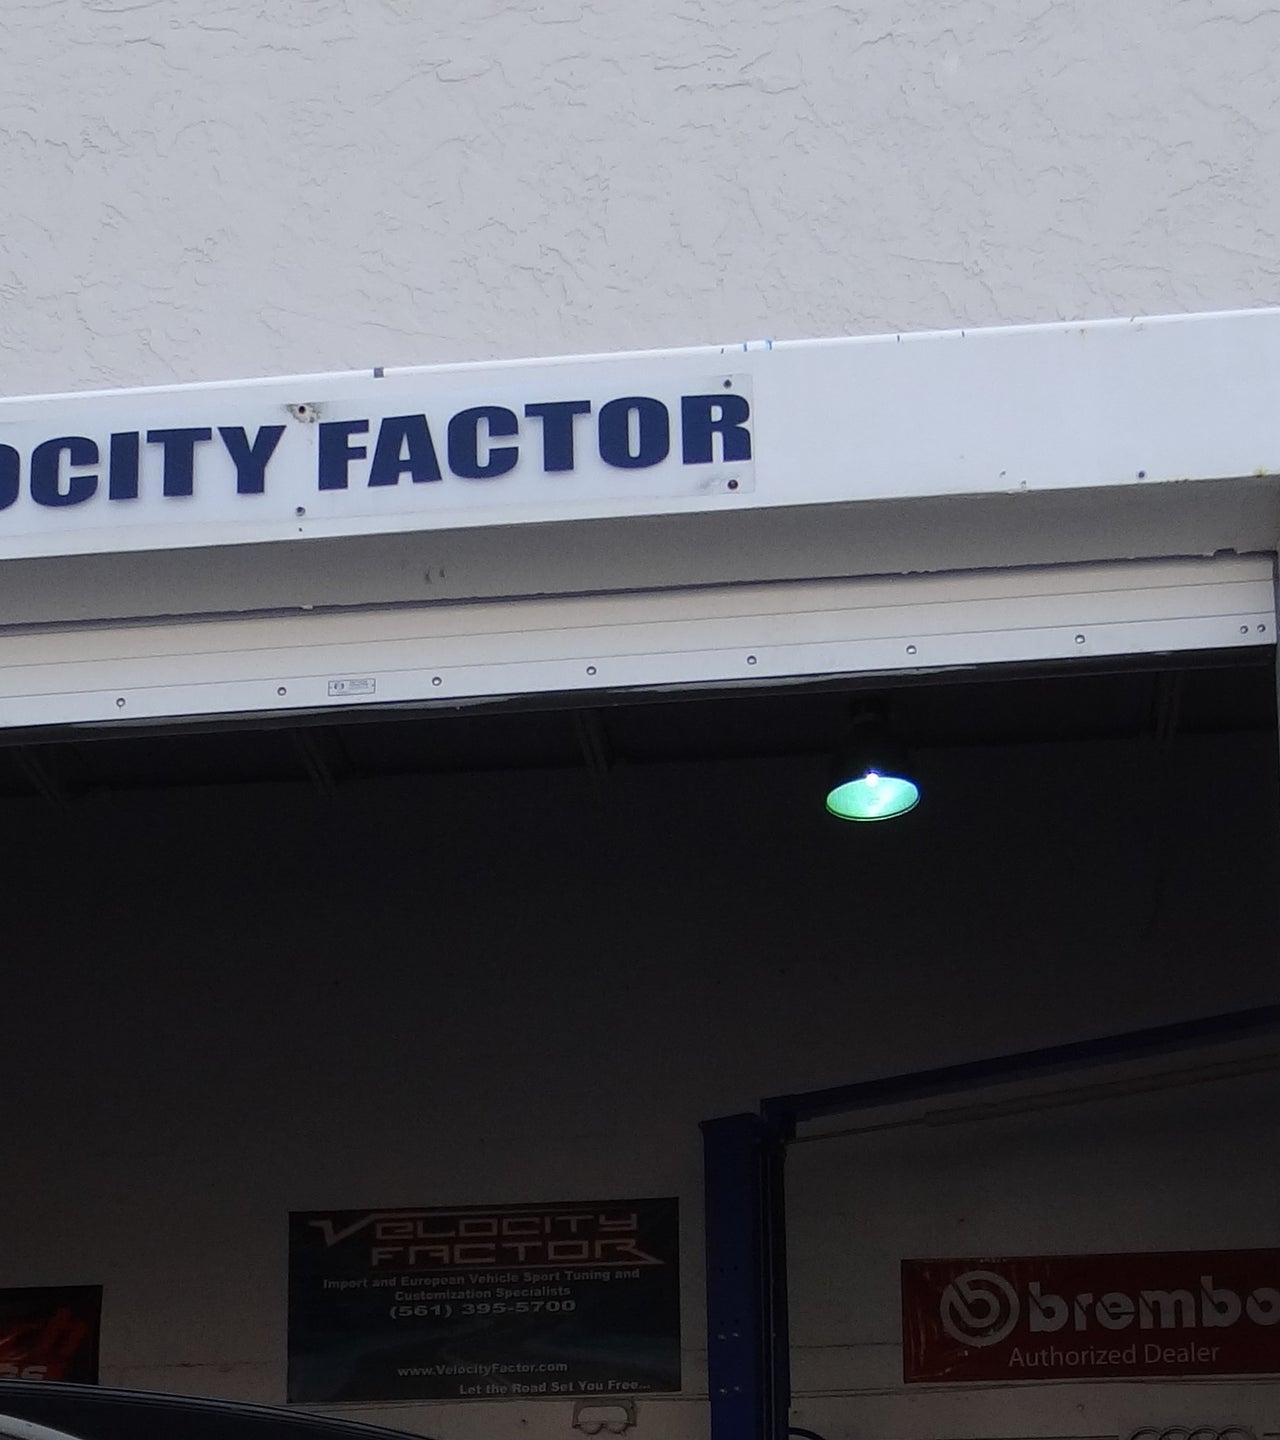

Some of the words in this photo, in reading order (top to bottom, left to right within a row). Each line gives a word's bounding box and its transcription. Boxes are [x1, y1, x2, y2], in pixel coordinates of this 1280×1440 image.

[320, 393, 753, 491] FACTOR
[370, 1237, 665, 1268] FACTOR
[322, 1277, 368, 1291] Import
[371, 1275, 397, 1289] and
[400, 1273, 466, 1289] European
[469, 1271, 521, 1285] Vehicle
[523, 1270, 561, 1285] Sport
[564, 1268, 612, 1283] Tuning
[615, 1267, 641, 1281] and
[394, 1287, 492, 1302] Customization
[494, 1284, 572, 1300] Specialists
[388, 1303, 453, 1319] (561)
[461, 1299, 577, 1317] 395-5700
[1007, 1343, 1138, 1369] Authorized
[1144, 1342, 1221, 1365] Dealer
[397, 1362, 568, 1377] www.VelocityFactor.com
[459, 1383, 482, 1395] Let
[486, 1383, 507, 1395] the
[511, 1381, 547, 1394] Road
[550, 1381, 574, 1393] Set
[577, 1380, 604, 1392] You
